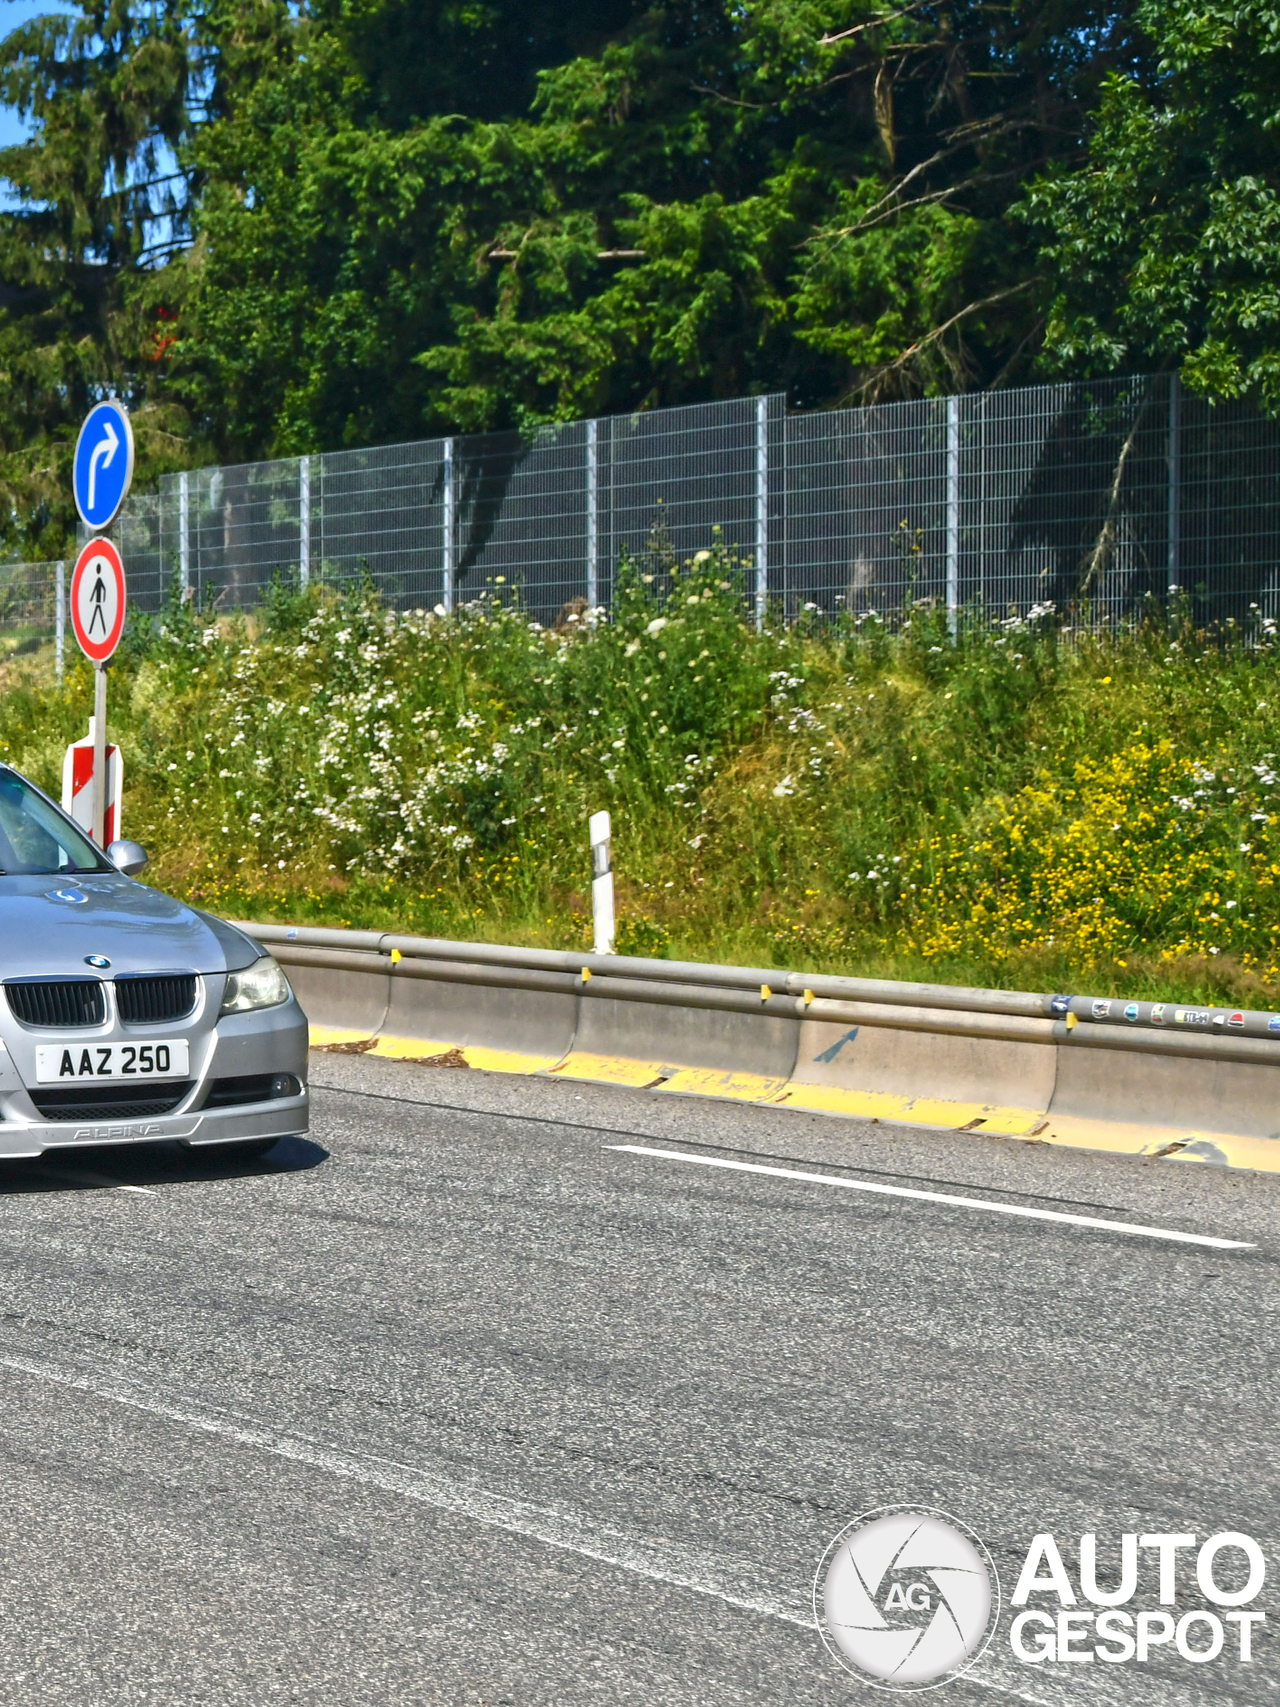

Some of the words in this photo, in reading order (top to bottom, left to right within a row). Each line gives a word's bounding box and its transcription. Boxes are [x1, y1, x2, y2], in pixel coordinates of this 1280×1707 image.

[59, 1048, 112, 1077] AAZ
[121, 1045, 171, 1074] 250
[73, 1124, 165, 1140] ALPINA
